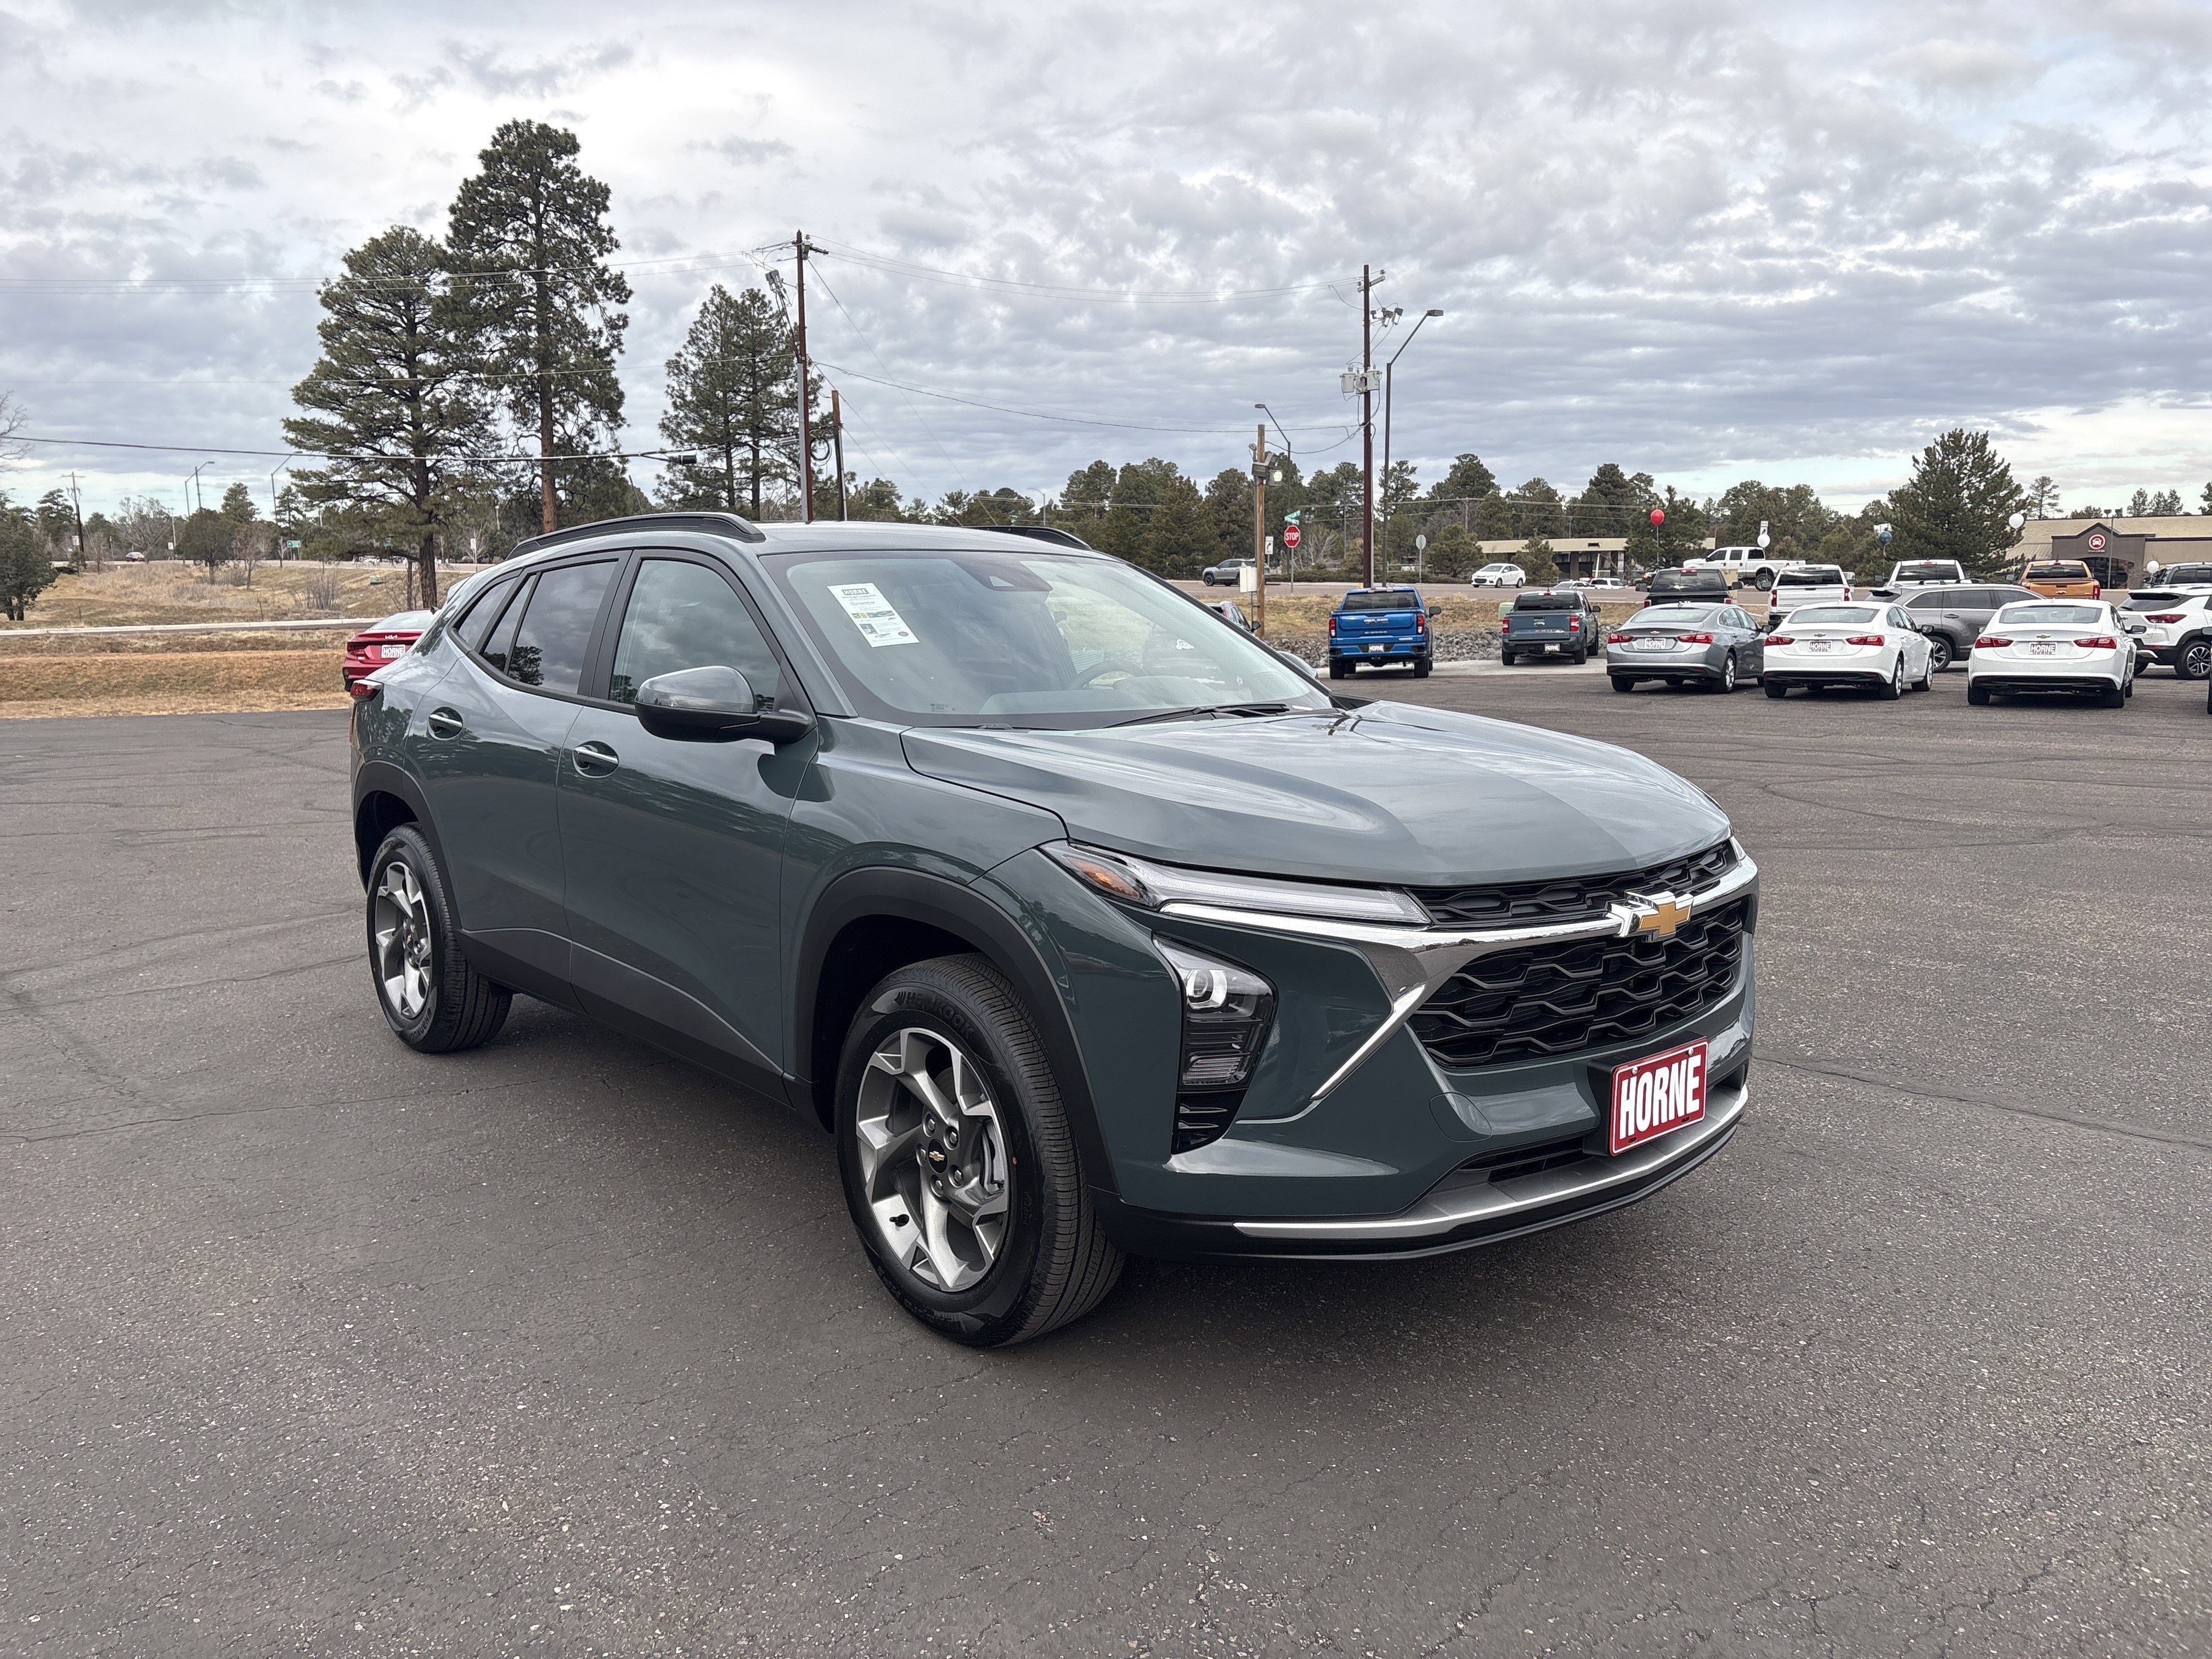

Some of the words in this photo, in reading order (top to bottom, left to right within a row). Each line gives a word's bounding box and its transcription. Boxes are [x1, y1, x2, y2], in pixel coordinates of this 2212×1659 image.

[1285, 532, 1299, 541] STOP
[383, 647, 404, 656] HORNE
[1619, 1054, 1701, 1140] HORNE
